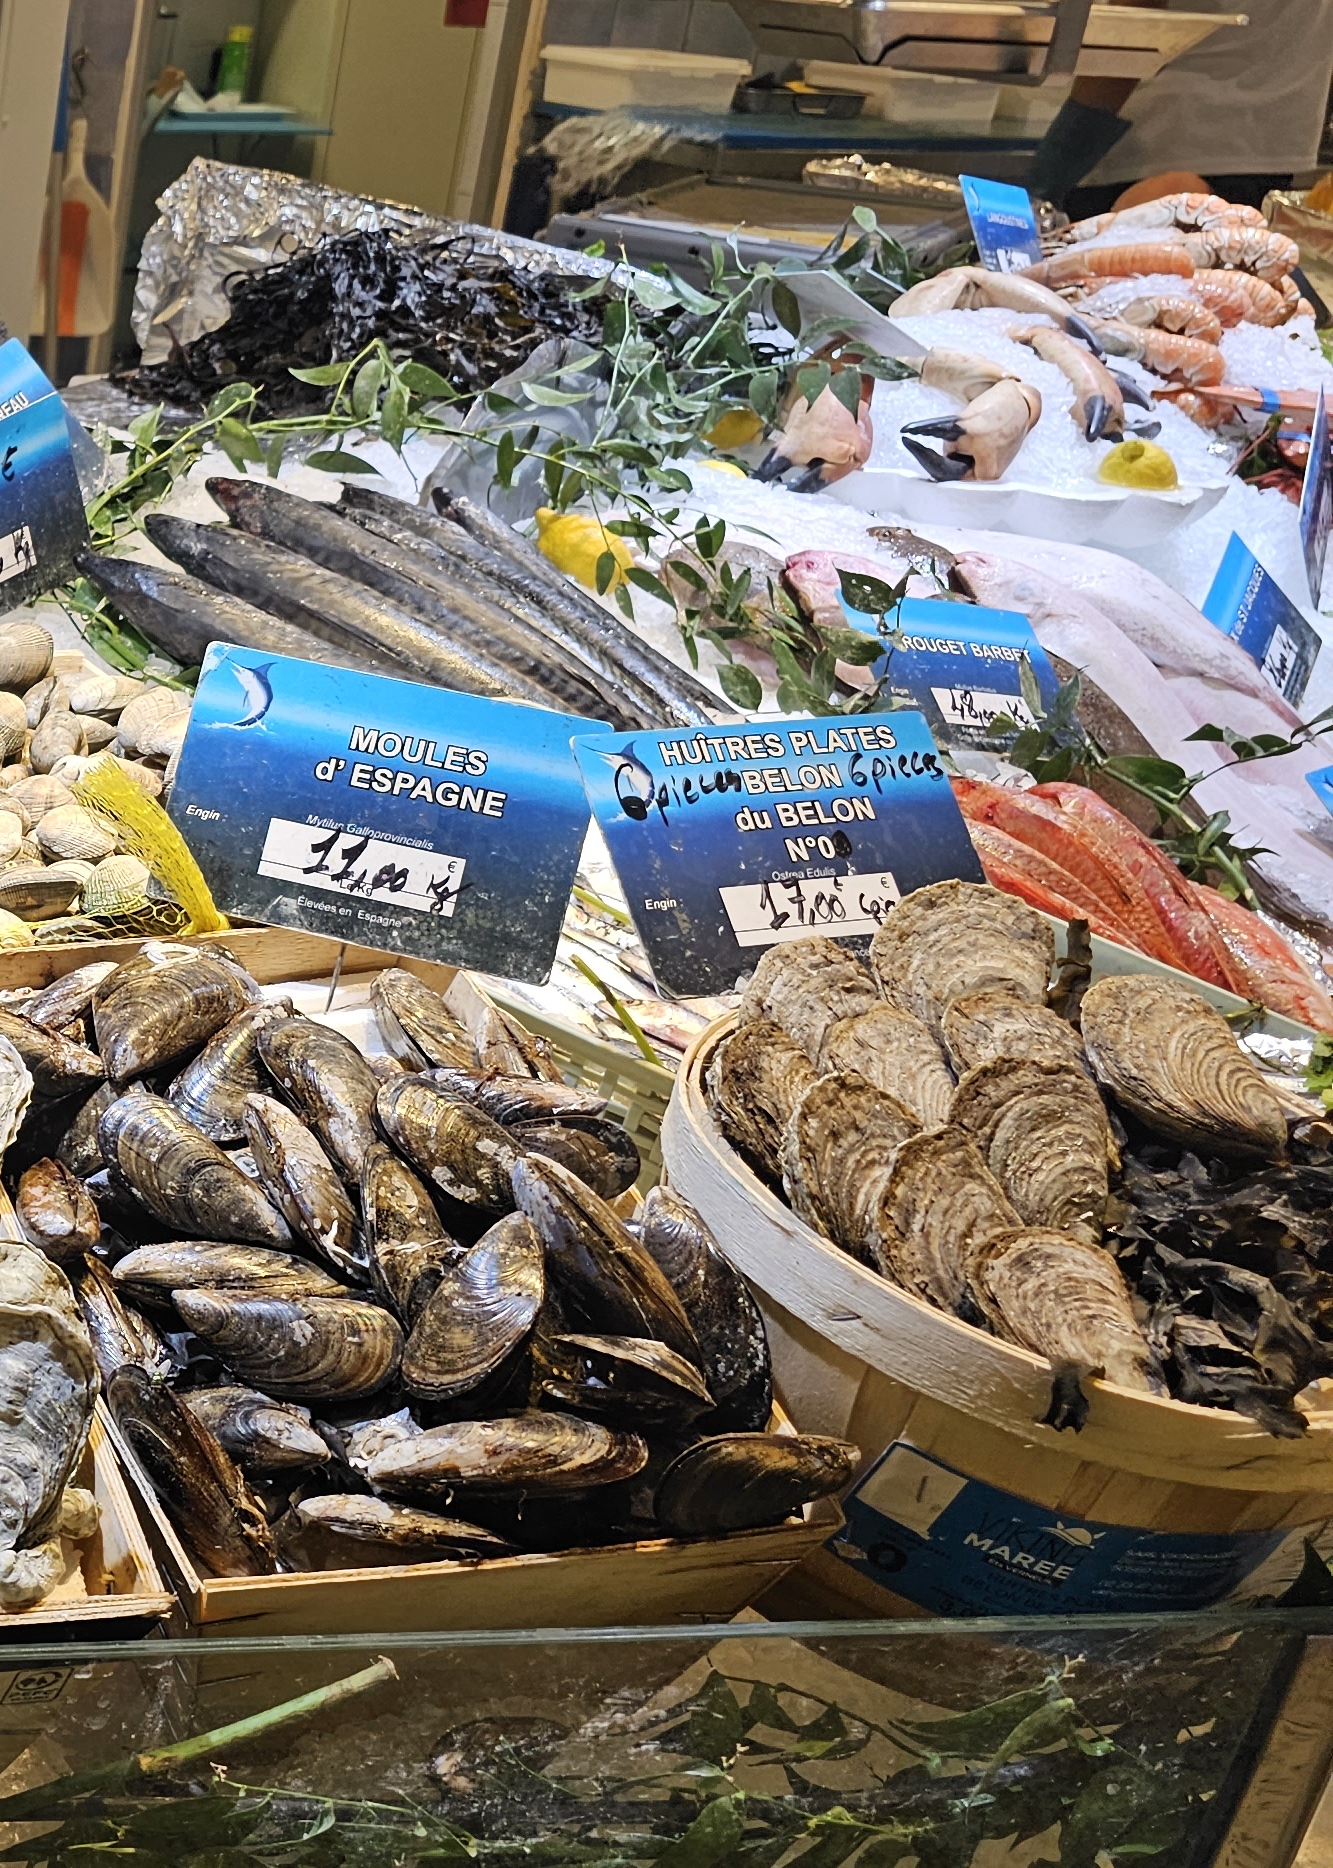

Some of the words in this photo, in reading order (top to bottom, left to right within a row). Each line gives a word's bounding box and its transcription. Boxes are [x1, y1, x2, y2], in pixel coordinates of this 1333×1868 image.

[902, 635, 967, 656] ROUGET
[348, 725, 490, 777] MOULES
[658, 731, 786, 768] HUÎTRES
[792, 724, 898, 757] PLATES
[314, 758, 345, 783] d'
[350, 766, 508, 818] ESPAGNE
[742, 763, 845, 796] BELON
[185, 804, 221, 822] Engin
[735, 806, 772, 831] du
[775, 796, 877, 829] BELON
[345, 822, 434, 852] Galloprovincialis
[771, 869, 805, 881] Ostrea
[806, 866, 836, 879] Edulis
[338, 907, 352, 917] en
[357, 908, 403, 930] Espagne
[645, 898, 677, 910] Engin
[963, 1532, 1075, 1581] MAREE
